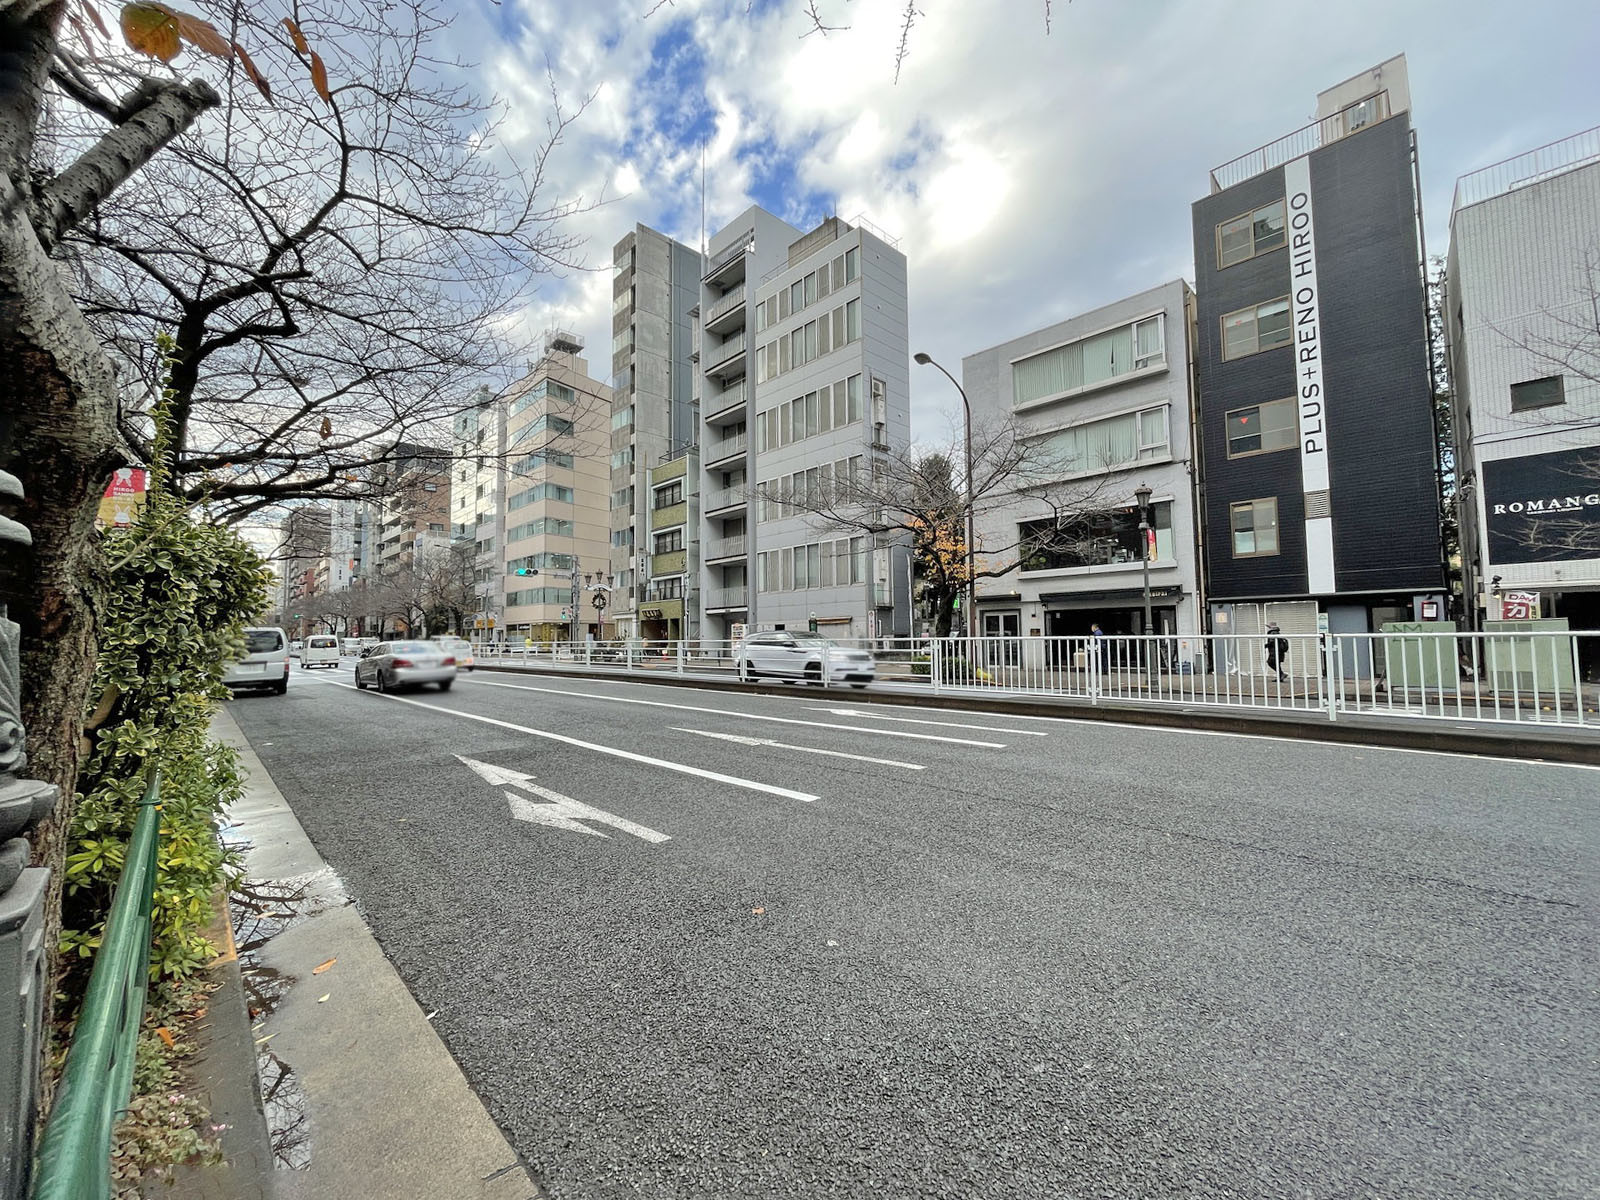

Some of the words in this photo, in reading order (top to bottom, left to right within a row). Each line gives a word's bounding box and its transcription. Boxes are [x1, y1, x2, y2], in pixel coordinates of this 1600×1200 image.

[1290, 192, 1313, 278] HIROO
[1296, 287, 1323, 454] PLUS+RENO
[1493, 494, 1600, 515] ROMANG
